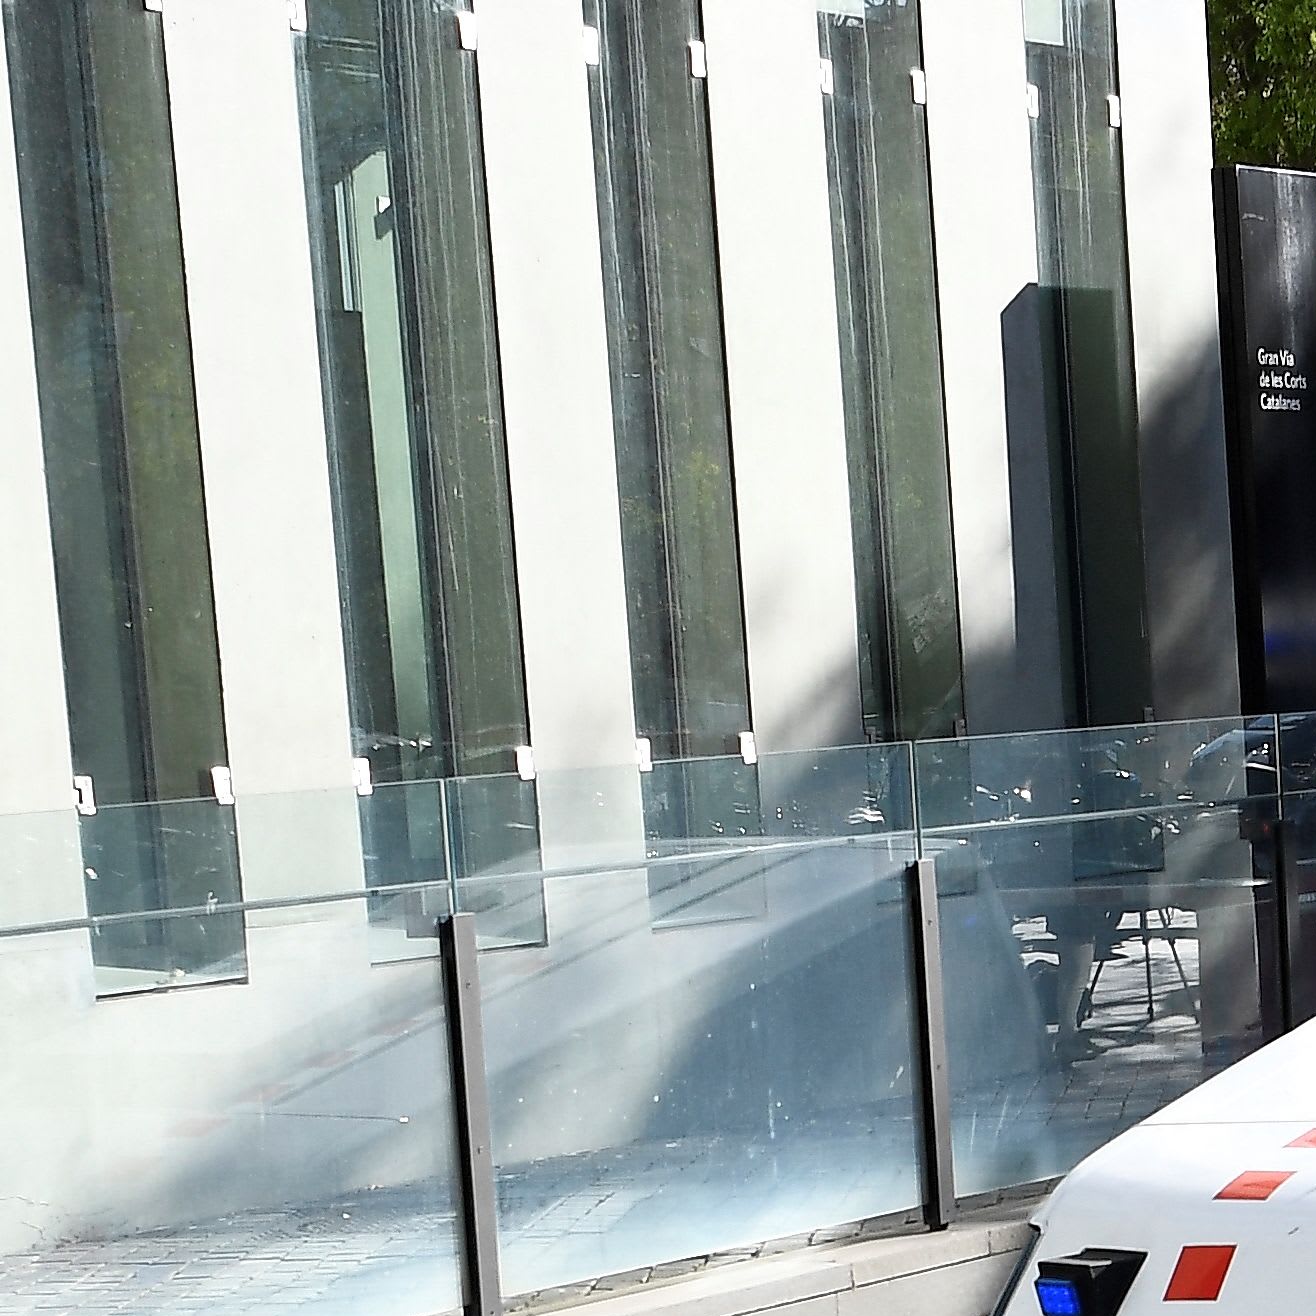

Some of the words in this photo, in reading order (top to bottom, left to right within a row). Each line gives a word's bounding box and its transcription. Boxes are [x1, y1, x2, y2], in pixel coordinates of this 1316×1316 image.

[1257, 347, 1279, 366] Gran
[1259, 370, 1271, 388] de
[1270, 370, 1284, 388] les
[1284, 371, 1307, 389] Corts
[1260, 392, 1301, 411] Catalanes
